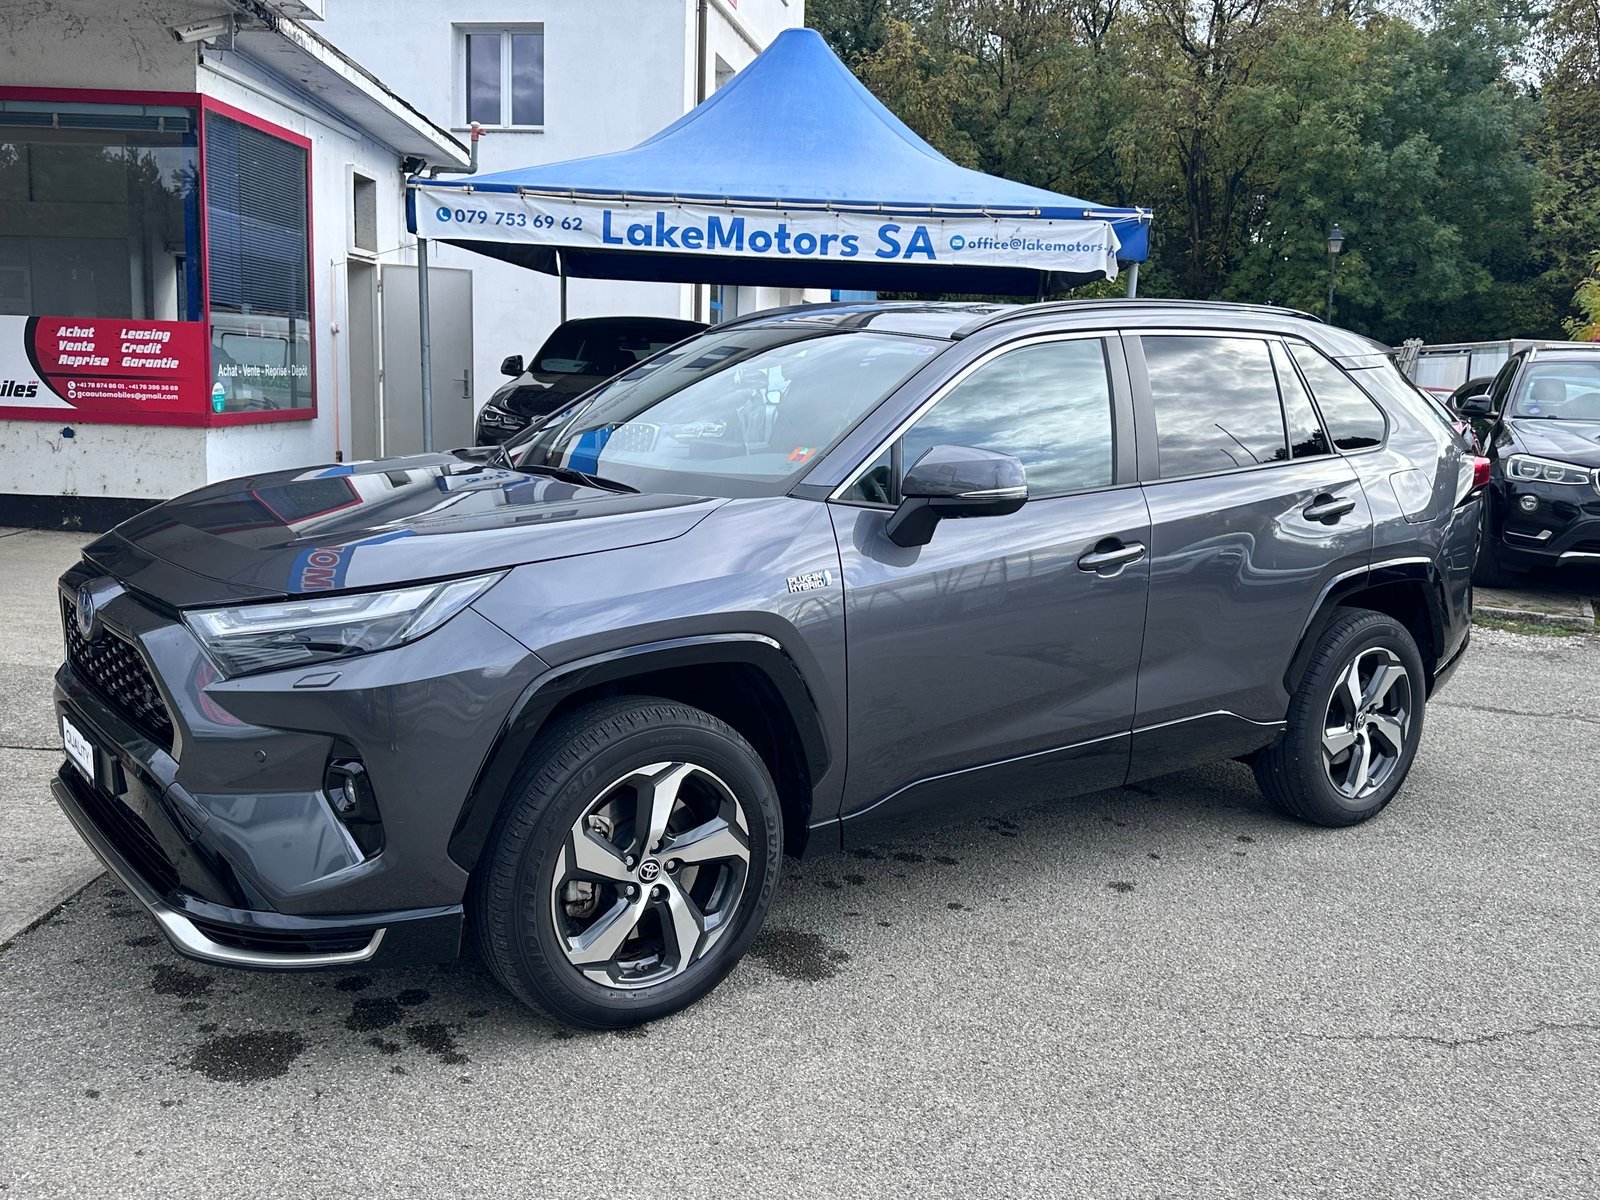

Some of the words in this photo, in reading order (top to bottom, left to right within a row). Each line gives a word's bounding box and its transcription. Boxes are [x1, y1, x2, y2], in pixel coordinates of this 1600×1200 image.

[454, 208, 488, 225] 079
[495, 211, 527, 228] 753
[533, 214, 555, 230] 69
[561, 216, 583, 232] 62
[602, 209, 860, 258] LakeMotors
[875, 223, 938, 261] SA
[968, 236, 1115, 259] office@lakemotors.h
[56, 326, 95, 338] Achat
[120, 328, 171, 343] Leasing
[59, 340, 96, 352] Vente
[121, 342, 162, 354] Credit
[58, 354, 110, 368] Reprise
[121, 356, 179, 369] Garantie
[218, 364, 238, 377] Achat
[242, 364, 261, 377] Vente
[265, 364, 288, 379] Reprise
[788, 579, 826, 594] HYBRID
